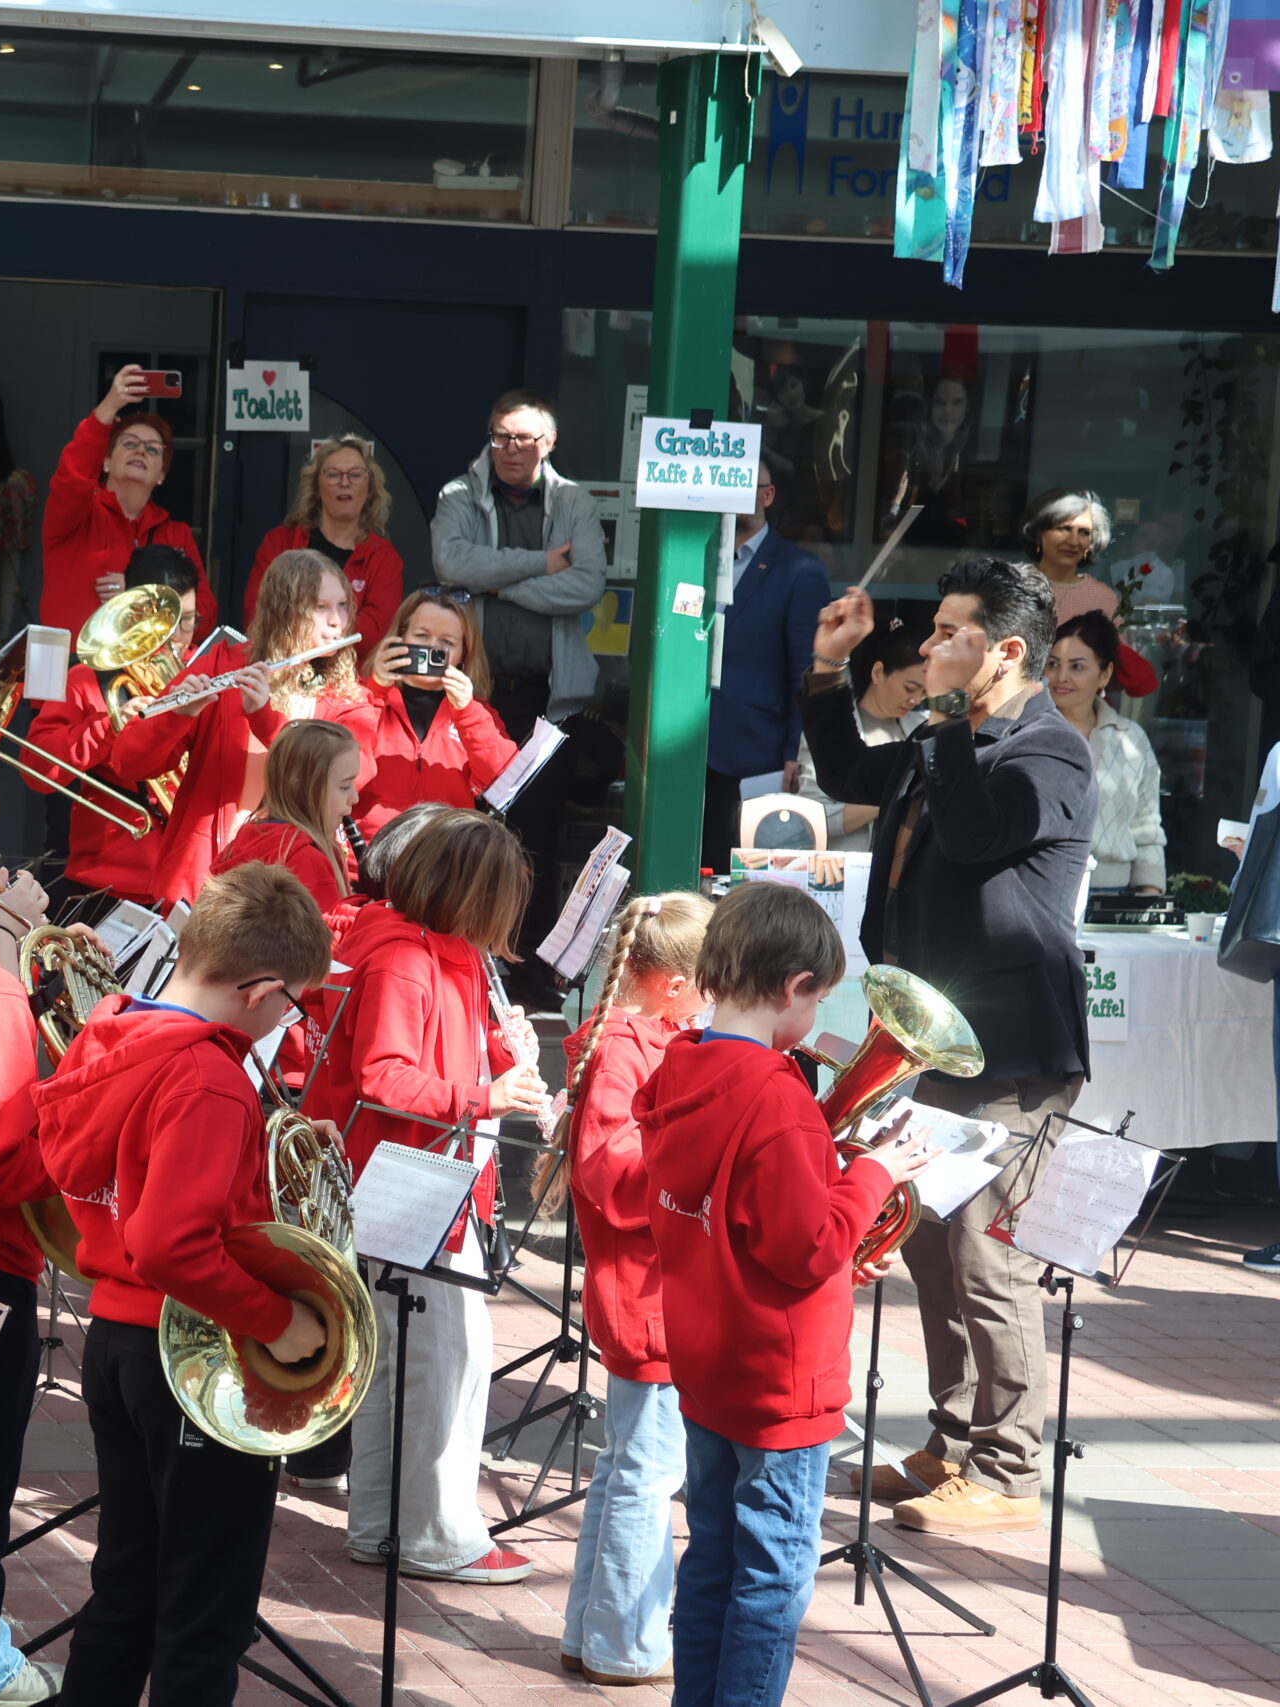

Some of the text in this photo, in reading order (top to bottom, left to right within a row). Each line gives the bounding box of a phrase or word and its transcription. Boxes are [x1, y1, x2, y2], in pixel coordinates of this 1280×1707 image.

[232, 388, 303, 421] Toalett
[655, 427, 746, 459] Gratis
[645, 461, 753, 488] Kaffe & Vaffel
